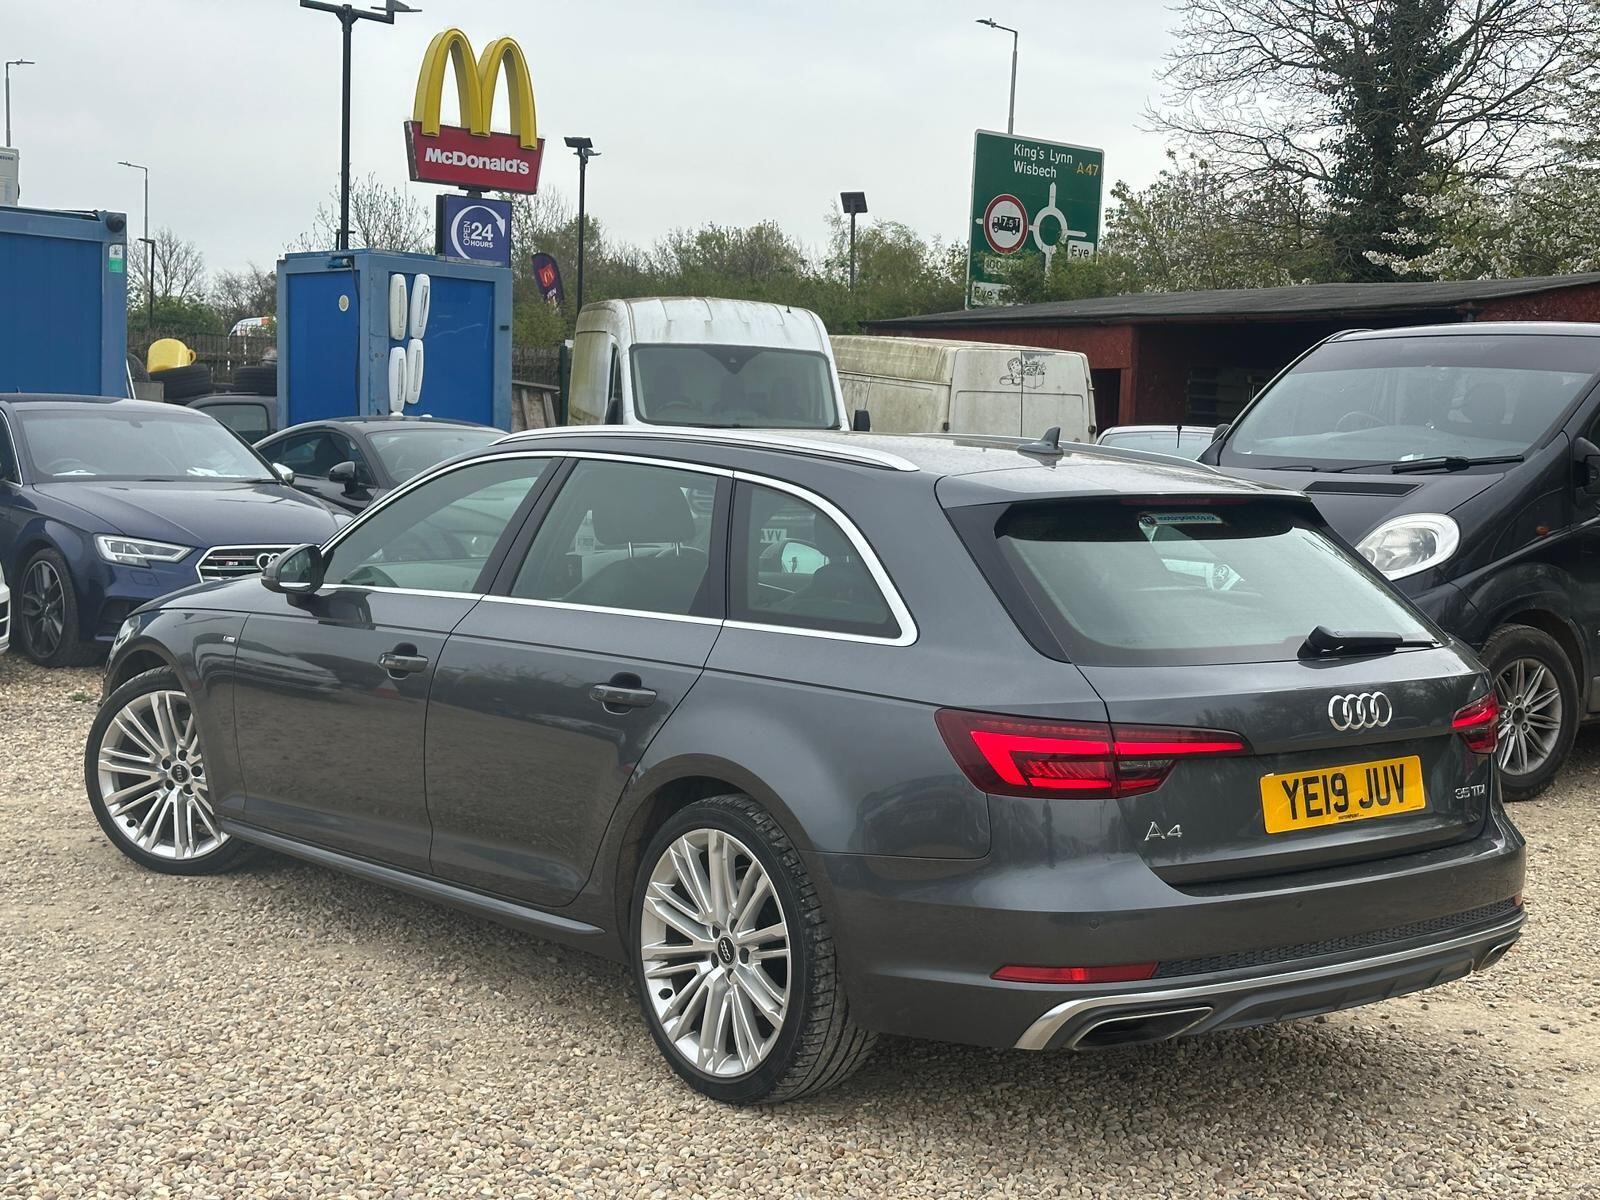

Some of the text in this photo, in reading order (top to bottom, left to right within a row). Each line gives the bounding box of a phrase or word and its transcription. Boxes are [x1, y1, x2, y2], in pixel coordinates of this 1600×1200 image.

[424, 147, 530, 175] McDonald's
[1013, 143, 1073, 164] King's Lynn
[1013, 160, 1057, 178] Wisbech
[1076, 162, 1099, 176] A47
[463, 220, 471, 246] OPEN
[470, 221, 494, 242] 24
[470, 240, 494, 249] HOURS
[1071, 245, 1090, 258] Eye
[1281, 764, 1404, 820] YE19 JUV
[1455, 784, 1486, 799] 35 TDI
[1144, 821, 1182, 841] A4
